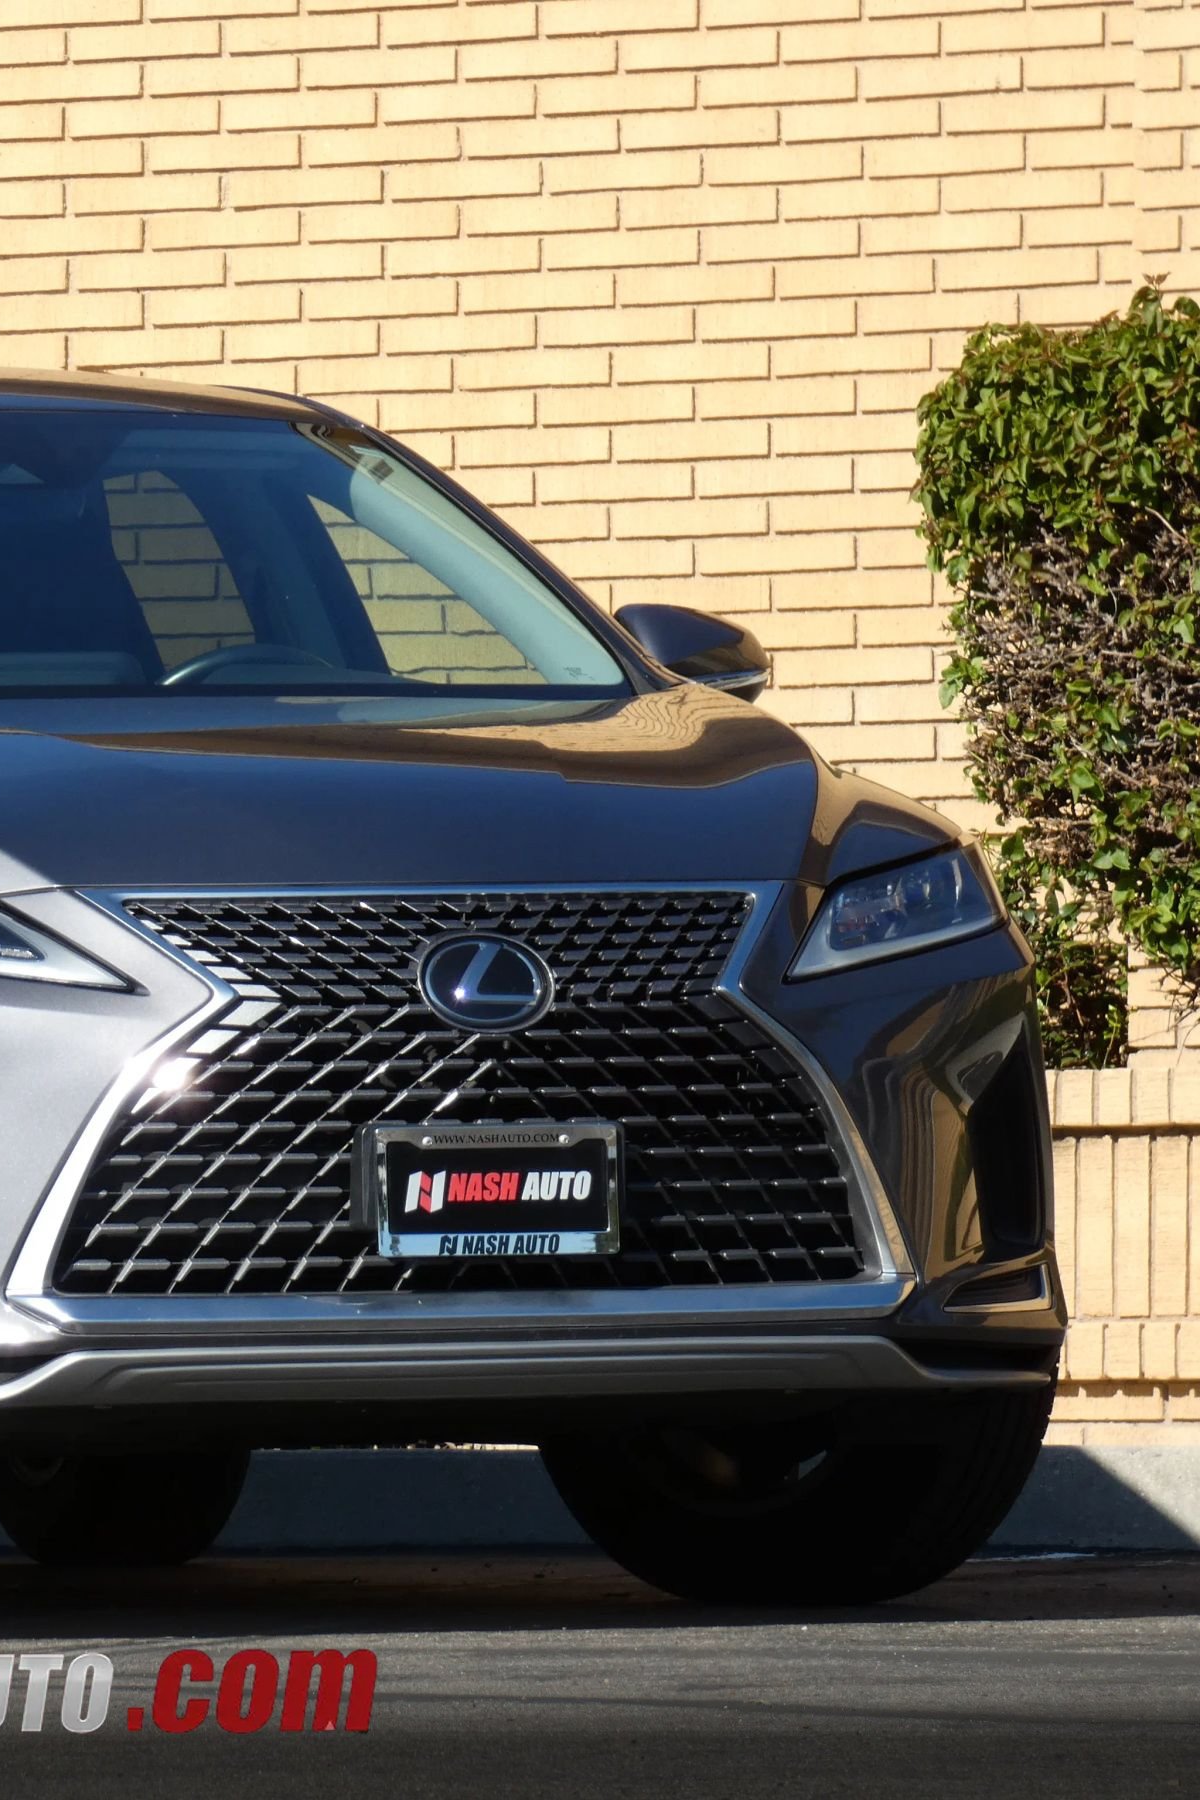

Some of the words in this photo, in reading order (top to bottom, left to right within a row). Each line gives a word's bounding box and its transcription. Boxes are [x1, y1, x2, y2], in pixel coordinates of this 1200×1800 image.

[433, 1132, 560, 1145] WWW.NASHAUTO.COM
[447, 1171, 520, 1202] NASH
[521, 1170, 592, 1201] AUTO
[462, 1234, 510, 1255] NASH
[512, 1234, 560, 1254] AUTO
